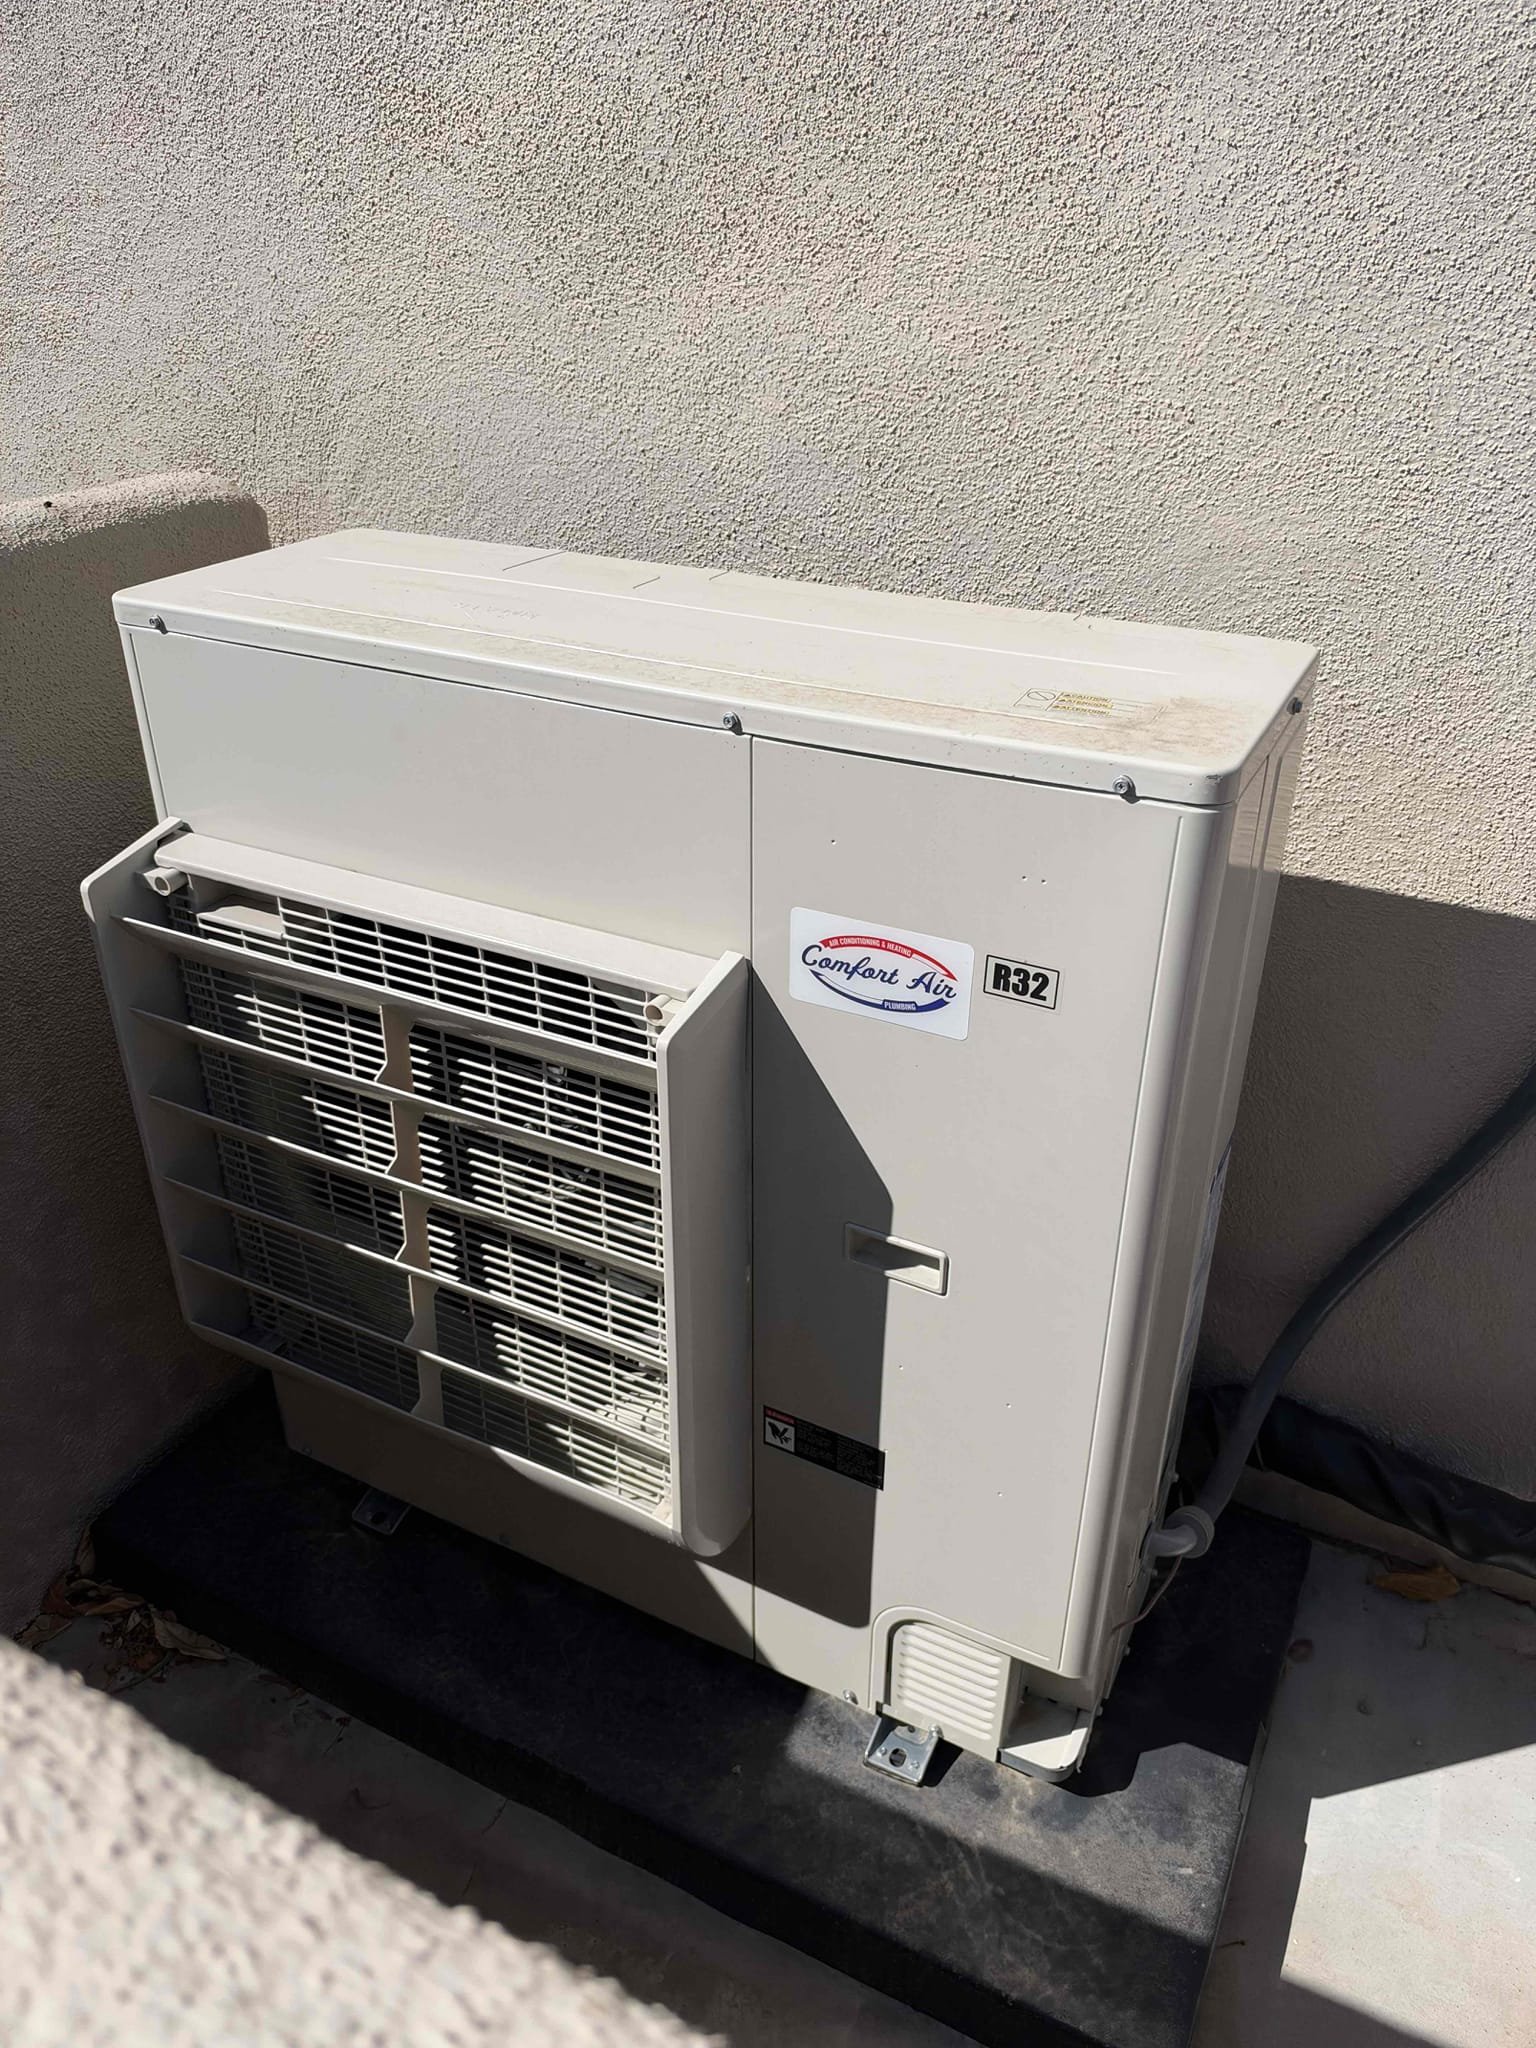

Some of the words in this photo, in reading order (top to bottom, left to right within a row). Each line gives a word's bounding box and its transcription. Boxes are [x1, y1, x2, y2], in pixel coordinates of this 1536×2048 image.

[828, 938, 839, 948] AIR
[840, 937, 880, 947] CONDITIONING
[887, 942, 912, 957] HEATING
[801, 944, 899, 985] Comfort
[906, 971, 957, 999] Air
[992, 962, 1049, 1001] R32
[884, 1001, 916, 1011] PLUMBING
